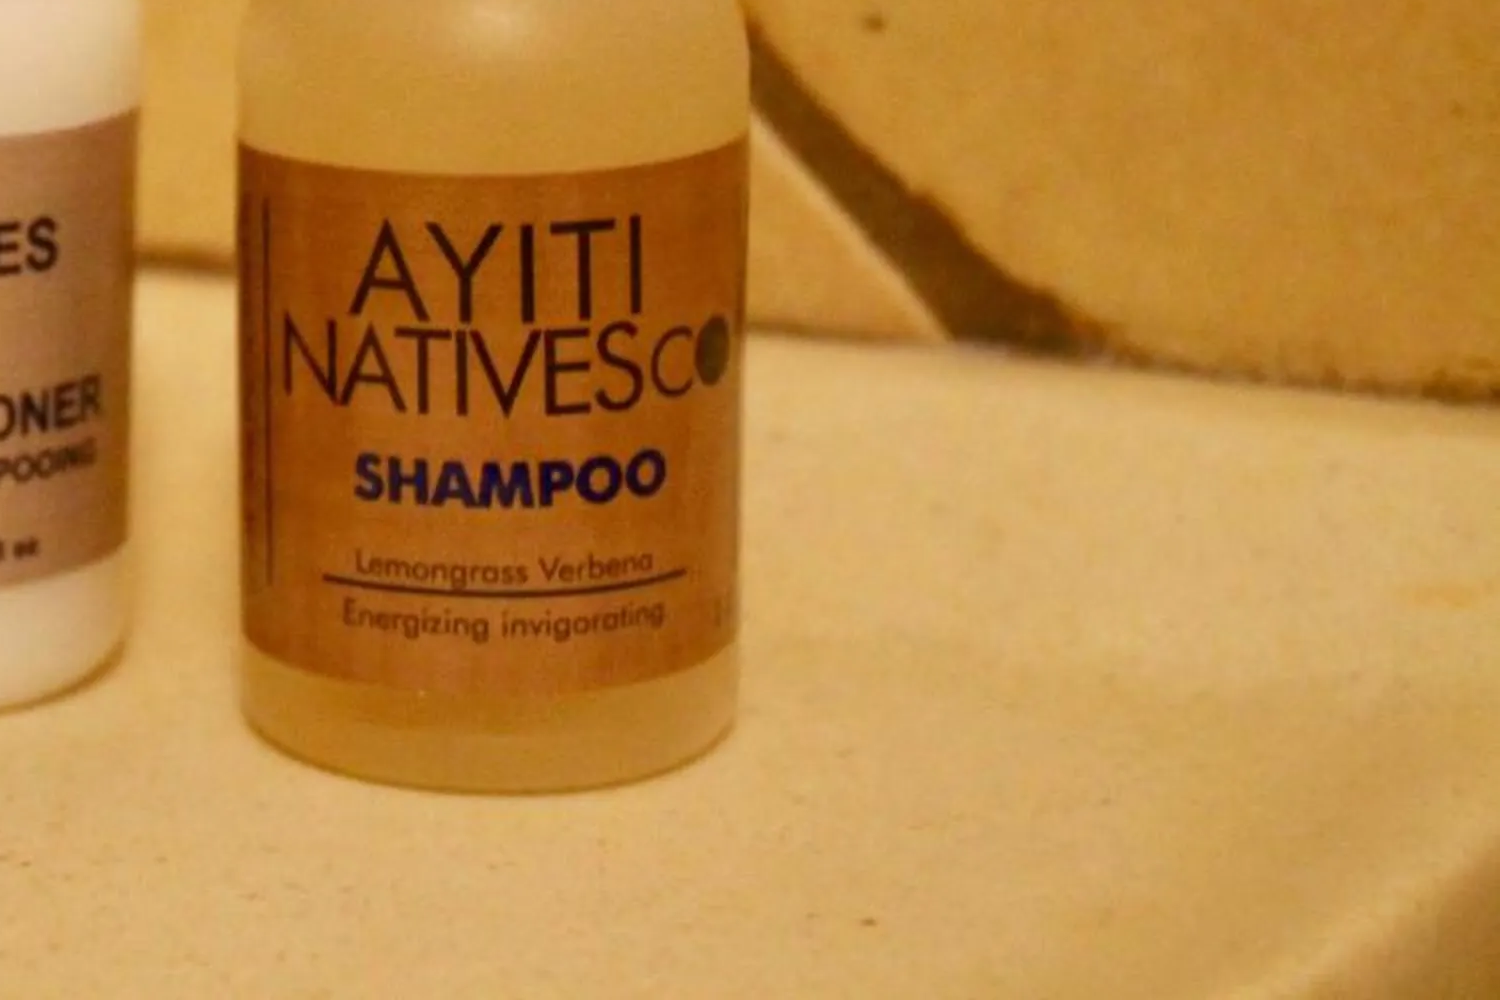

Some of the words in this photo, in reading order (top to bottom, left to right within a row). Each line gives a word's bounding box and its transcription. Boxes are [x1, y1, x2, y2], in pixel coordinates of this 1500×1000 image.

[348, 213, 642, 324] AYITI
[354, 448, 668, 508] SHAMPOO
[355, 548, 529, 592] Lemongrass
[538, 551, 654, 582] Verbena
[342, 597, 490, 644] Energizing
[500, 600, 666, 642] invigorating
